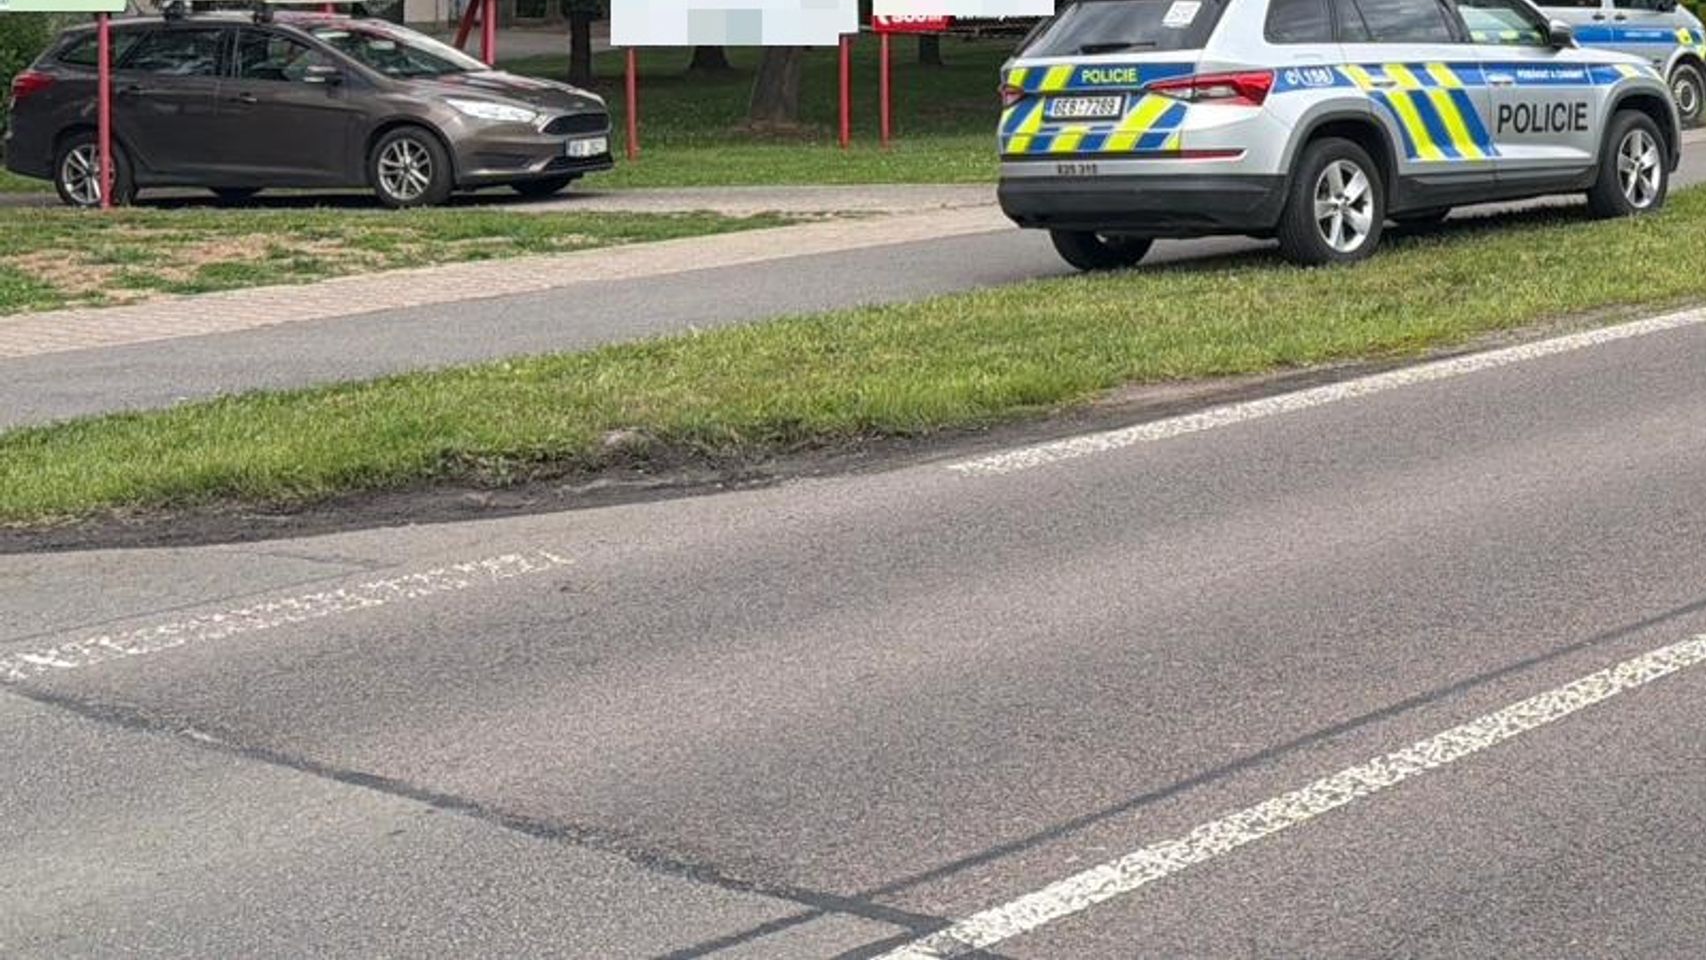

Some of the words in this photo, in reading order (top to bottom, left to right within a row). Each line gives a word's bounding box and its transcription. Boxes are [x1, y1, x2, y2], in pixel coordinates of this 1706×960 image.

[1081, 67, 1138, 84] POLICIE
[1303, 69, 1329, 83] 158
[1497, 102, 1588, 133] POLICIE
